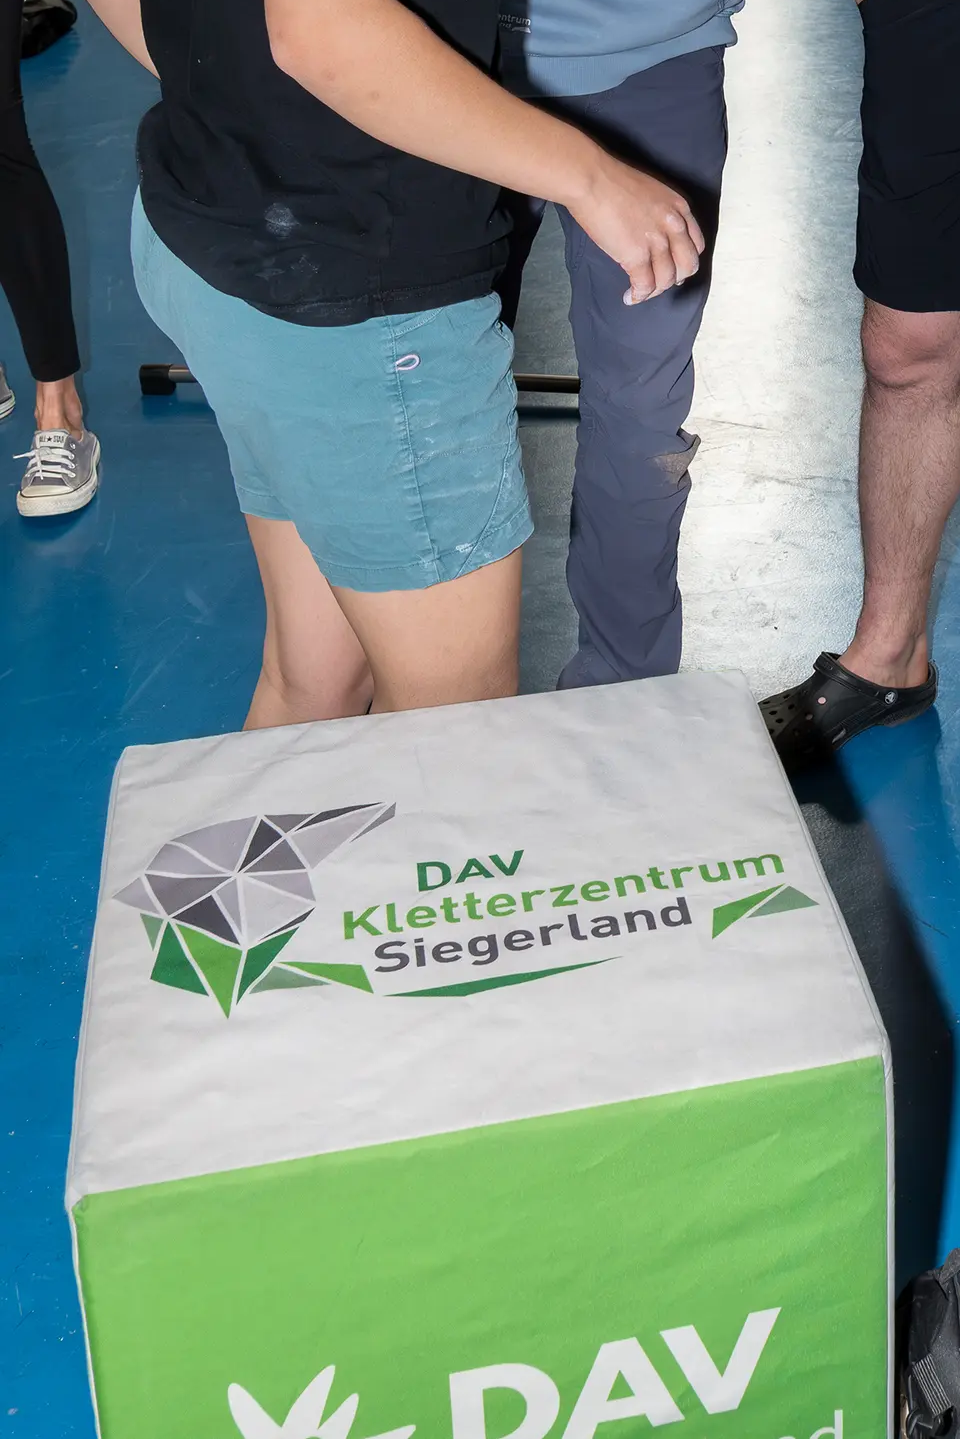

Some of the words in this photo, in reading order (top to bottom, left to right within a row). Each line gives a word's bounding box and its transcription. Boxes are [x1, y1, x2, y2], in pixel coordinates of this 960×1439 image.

[343, 853, 785, 940] Kletterzentrum
[416, 849, 525, 892] DAV
[374, 896, 692, 973] Siegerland
[449, 1307, 782, 1439] DAV
